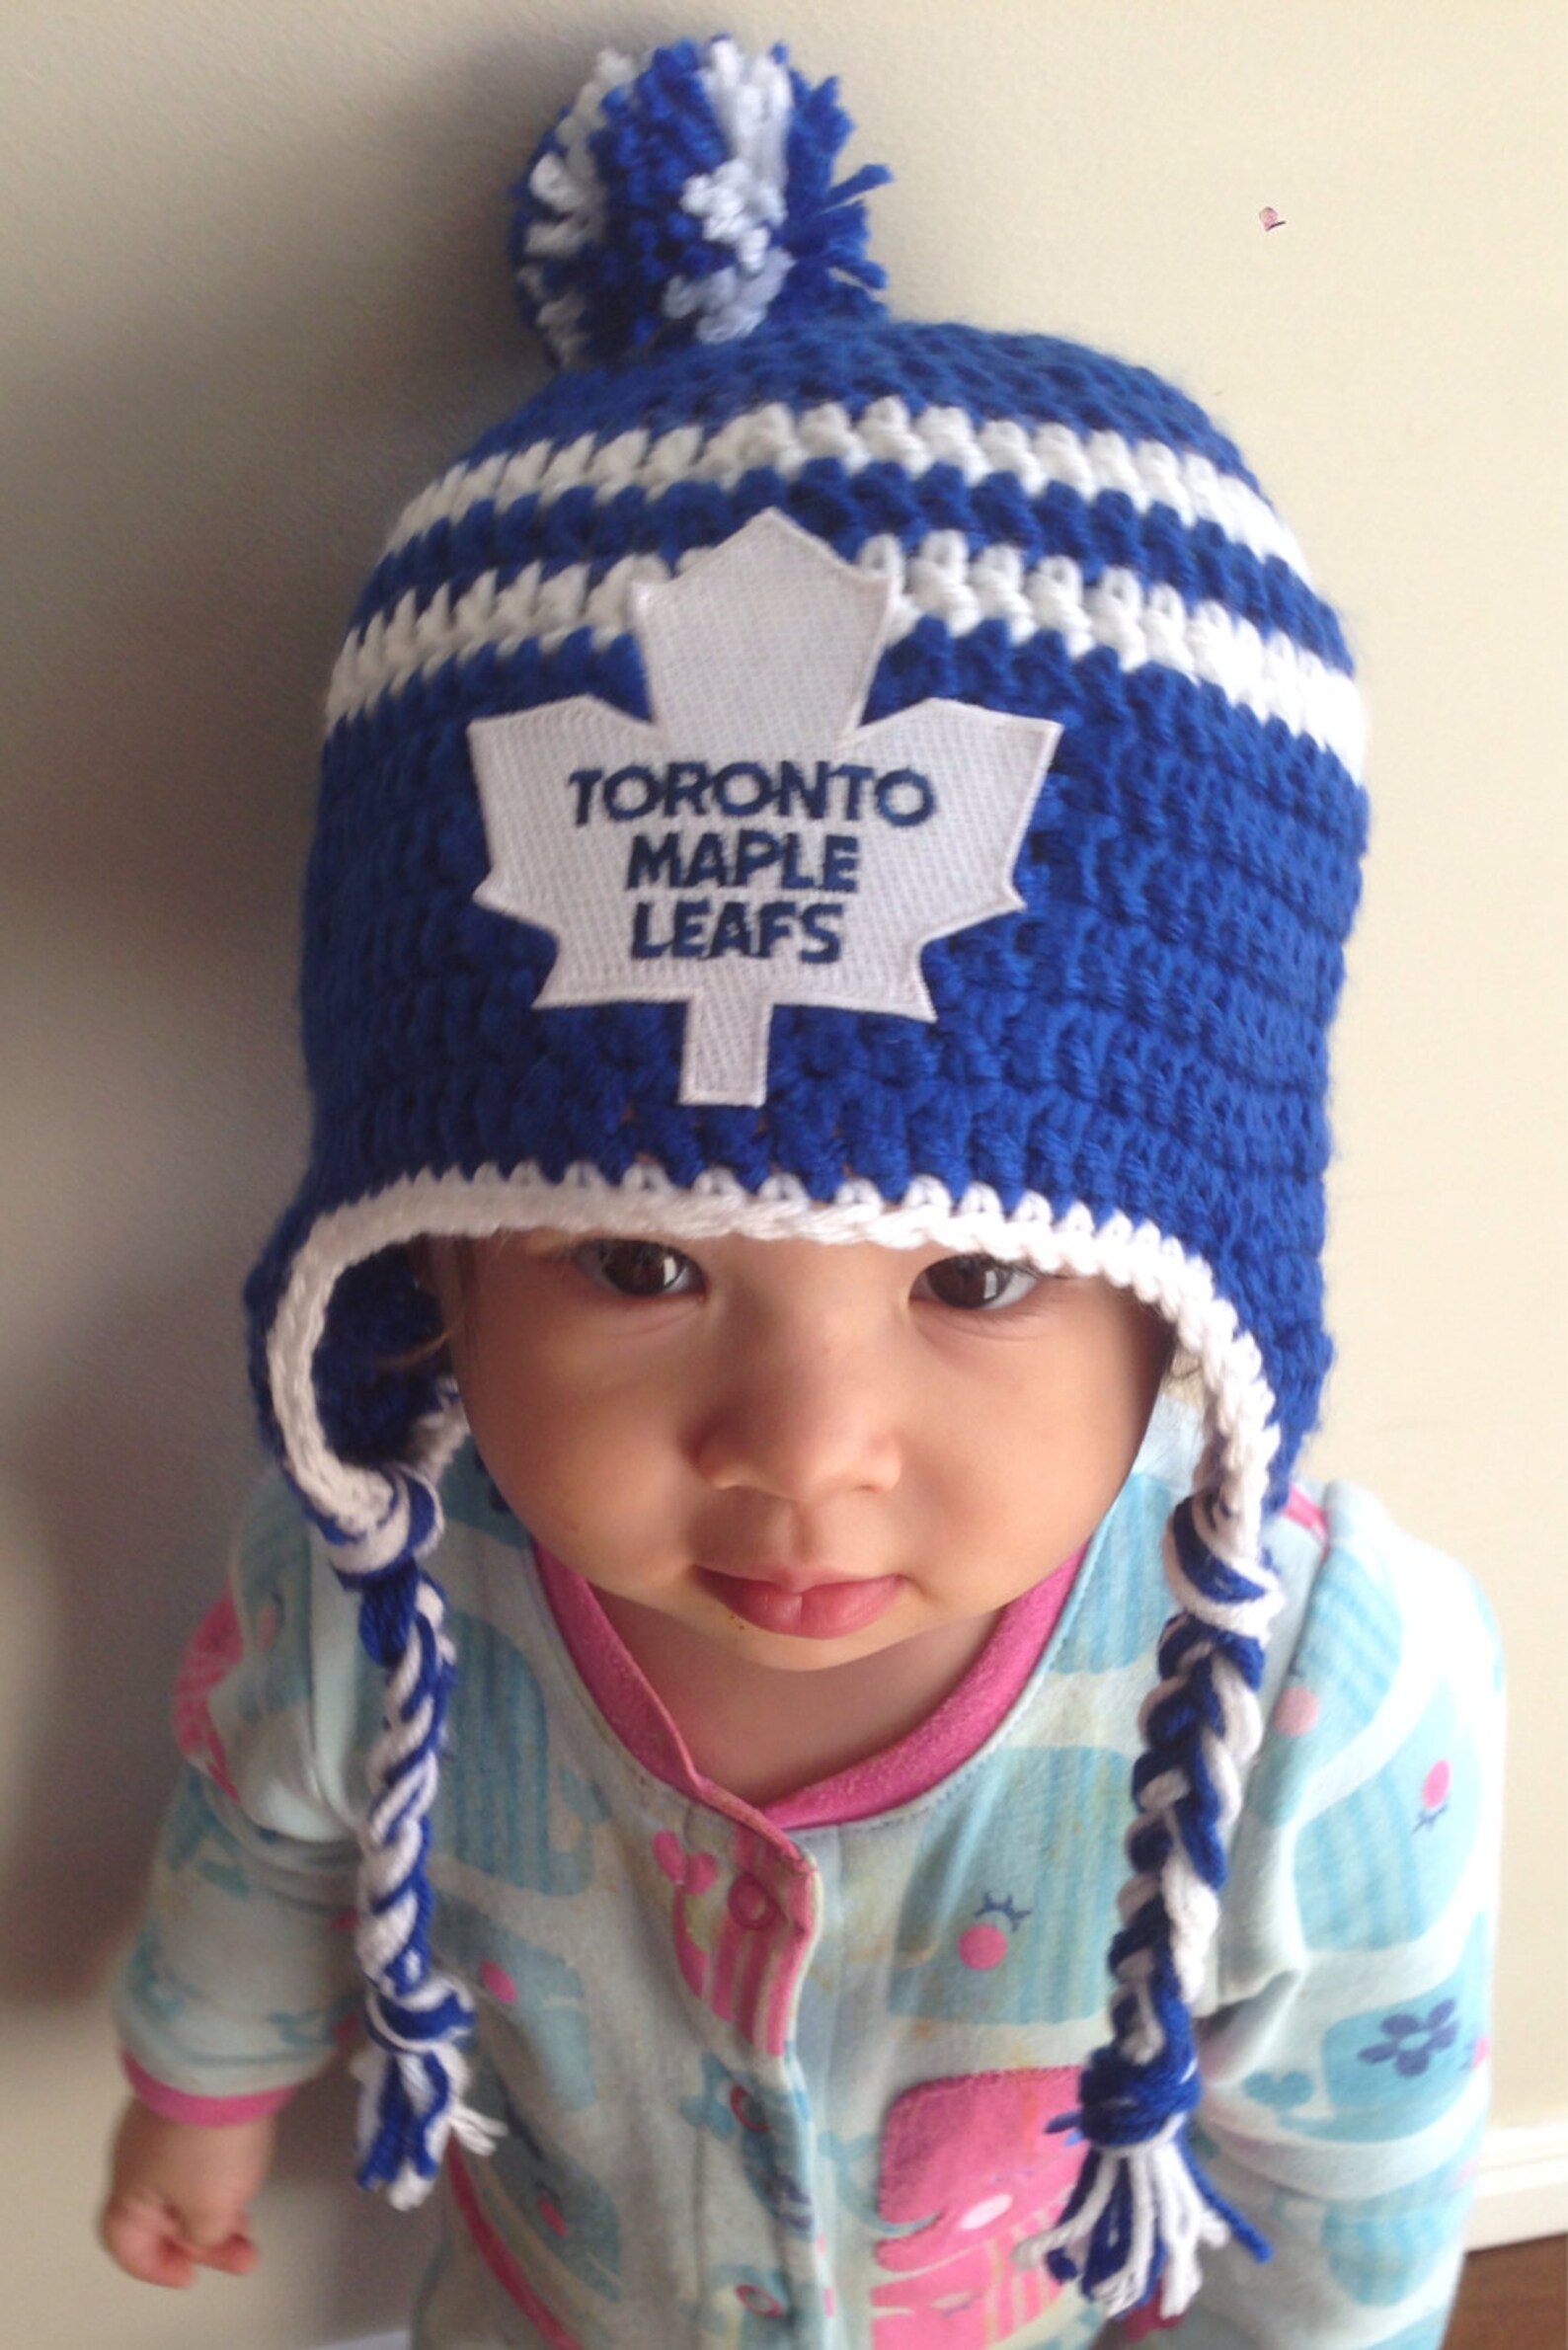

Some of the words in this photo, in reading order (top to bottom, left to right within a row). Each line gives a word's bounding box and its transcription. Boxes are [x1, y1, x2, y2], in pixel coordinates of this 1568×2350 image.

[568, 759, 936, 827] TORONTO
[625, 828, 859, 893] MAPLE
[630, 898, 844, 965] LEAFS
